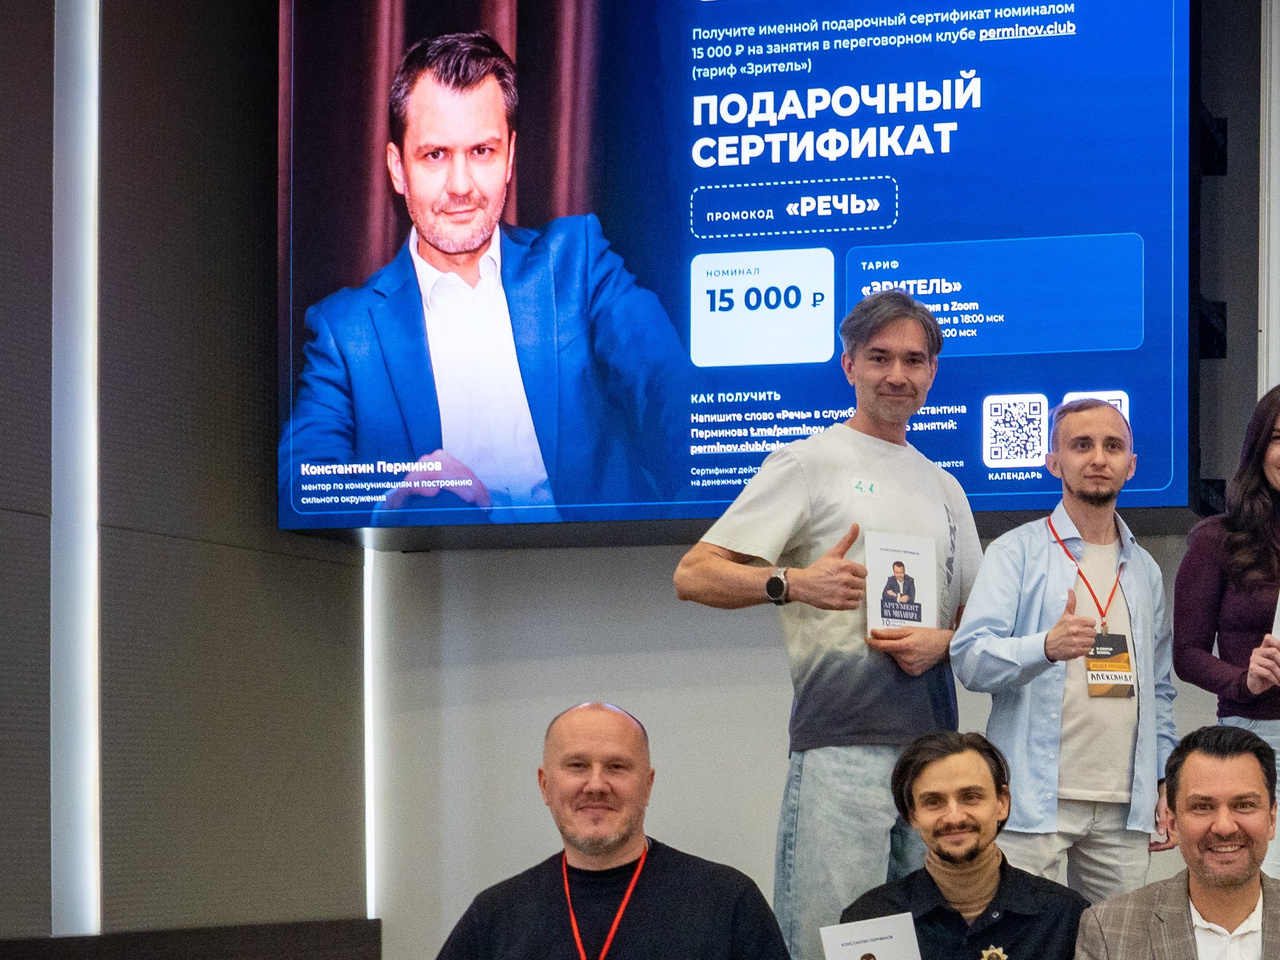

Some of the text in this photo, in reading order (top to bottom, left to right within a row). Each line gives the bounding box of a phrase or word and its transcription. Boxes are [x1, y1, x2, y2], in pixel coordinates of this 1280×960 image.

[693, 3, 1074, 41] Получите именной подарочный сертификат номиналом
[692, 47, 704, 59] 15
[707, 45, 731, 58] 000
[748, 45, 763, 56] на
[767, 41, 819, 54] занятия
[823, 41, 830, 50] в
[834, 33, 931, 51] переговорном
[936, 28, 976, 44] клубе
[980, 20, 1076, 42] perminov.club
[693, 58, 811, 80] (тариф «Зритель»)
[693, 69, 981, 127] ПОДАРОЧНЫЙ
[692, 122, 957, 168] СЕРТИФИКАТ
[707, 194, 880, 221] ПРОМОКОД «РЕЧЬ»
[707, 268, 759, 277] НОМИНАЛ
[861, 260, 899, 270] ТАРИФ
[706, 289, 734, 312] 15
[745, 285, 801, 311] 000
[951, 301, 979, 311] Zoom
[960, 314, 984, 324] 18:00
[942, 328, 977, 338] :00 мск
[691, 391, 780, 403] КАК ПОЛУЧИТЬ
[691, 413, 742, 423] Напишите
[745, 412, 774, 421] слово
[776, 410, 812, 420] «Речь»
[814, 411, 820, 419] в
[914, 405, 967, 415] стантина
[691, 428, 748, 439] Перминова
[913, 420, 957, 431] занятий:
[301, 460, 442, 475] Константин Перминов
[691, 467, 737, 477] Сертификат
[702, 479, 741, 487] денежные
[989, 472, 1042, 481] КАЛЕНДАРЬ
